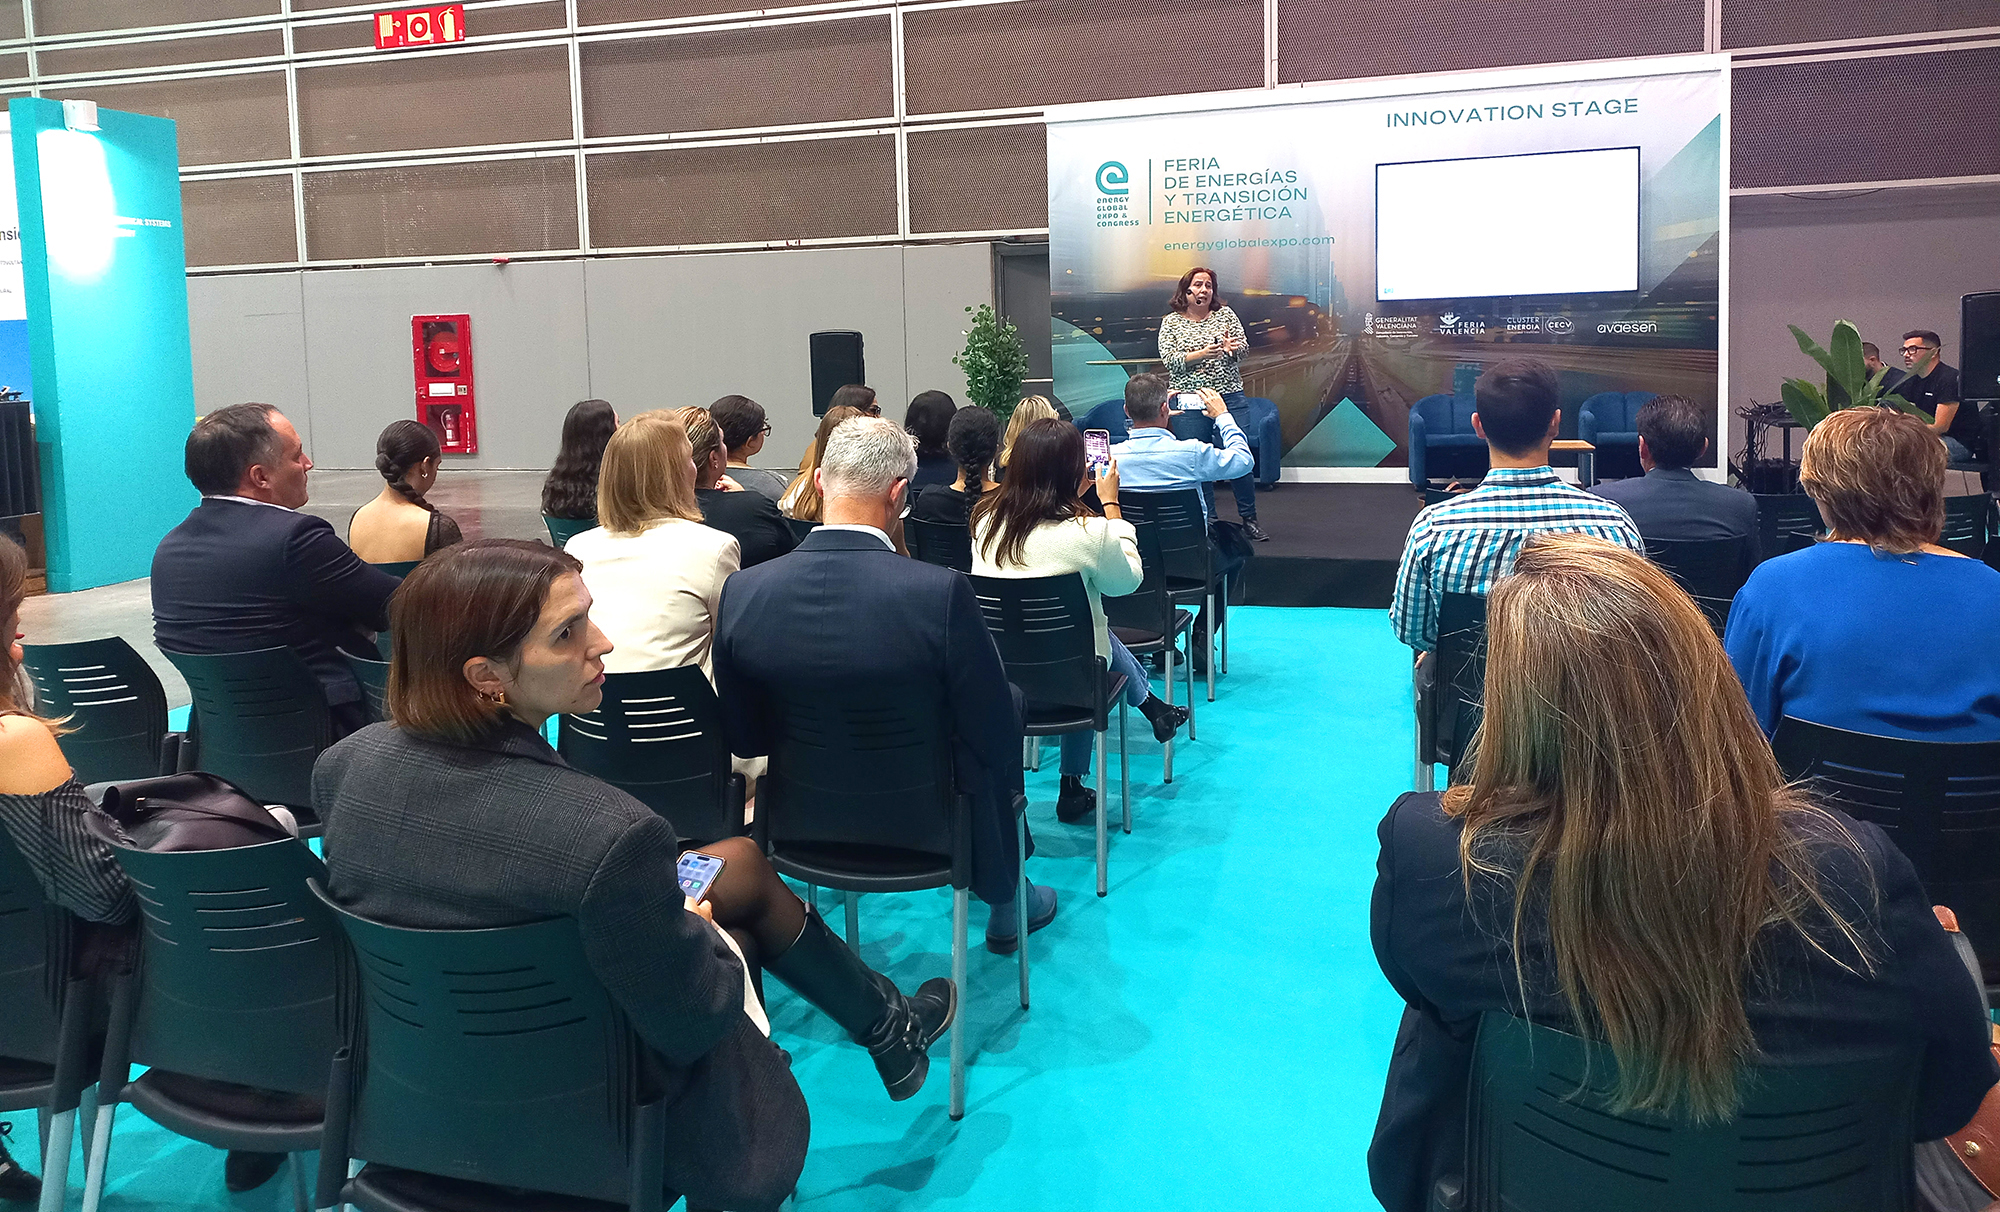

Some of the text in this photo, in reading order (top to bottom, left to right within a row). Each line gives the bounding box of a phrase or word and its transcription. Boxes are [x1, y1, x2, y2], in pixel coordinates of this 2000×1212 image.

[1387, 98, 1638, 127] INNOVATION STAGE
[1164, 157, 1220, 172] FERIA
[1164, 168, 1298, 189] DE ENERGÍAS
[1164, 185, 1308, 206] Y TRANSICIÓN
[1164, 205, 1292, 224] ENERGÉTICA
[1164, 235, 1335, 251] energyglobalexpo.com
[1375, 316, 1418, 324] GENERALITAT
[1458, 321, 1486, 329] FERIA
[1506, 316, 1540, 324] CLUSTER
[1548, 321, 1572, 329] CECV
[1440, 328, 1486, 336] VALENCIA
[1597, 323, 1657, 335] avaesen
